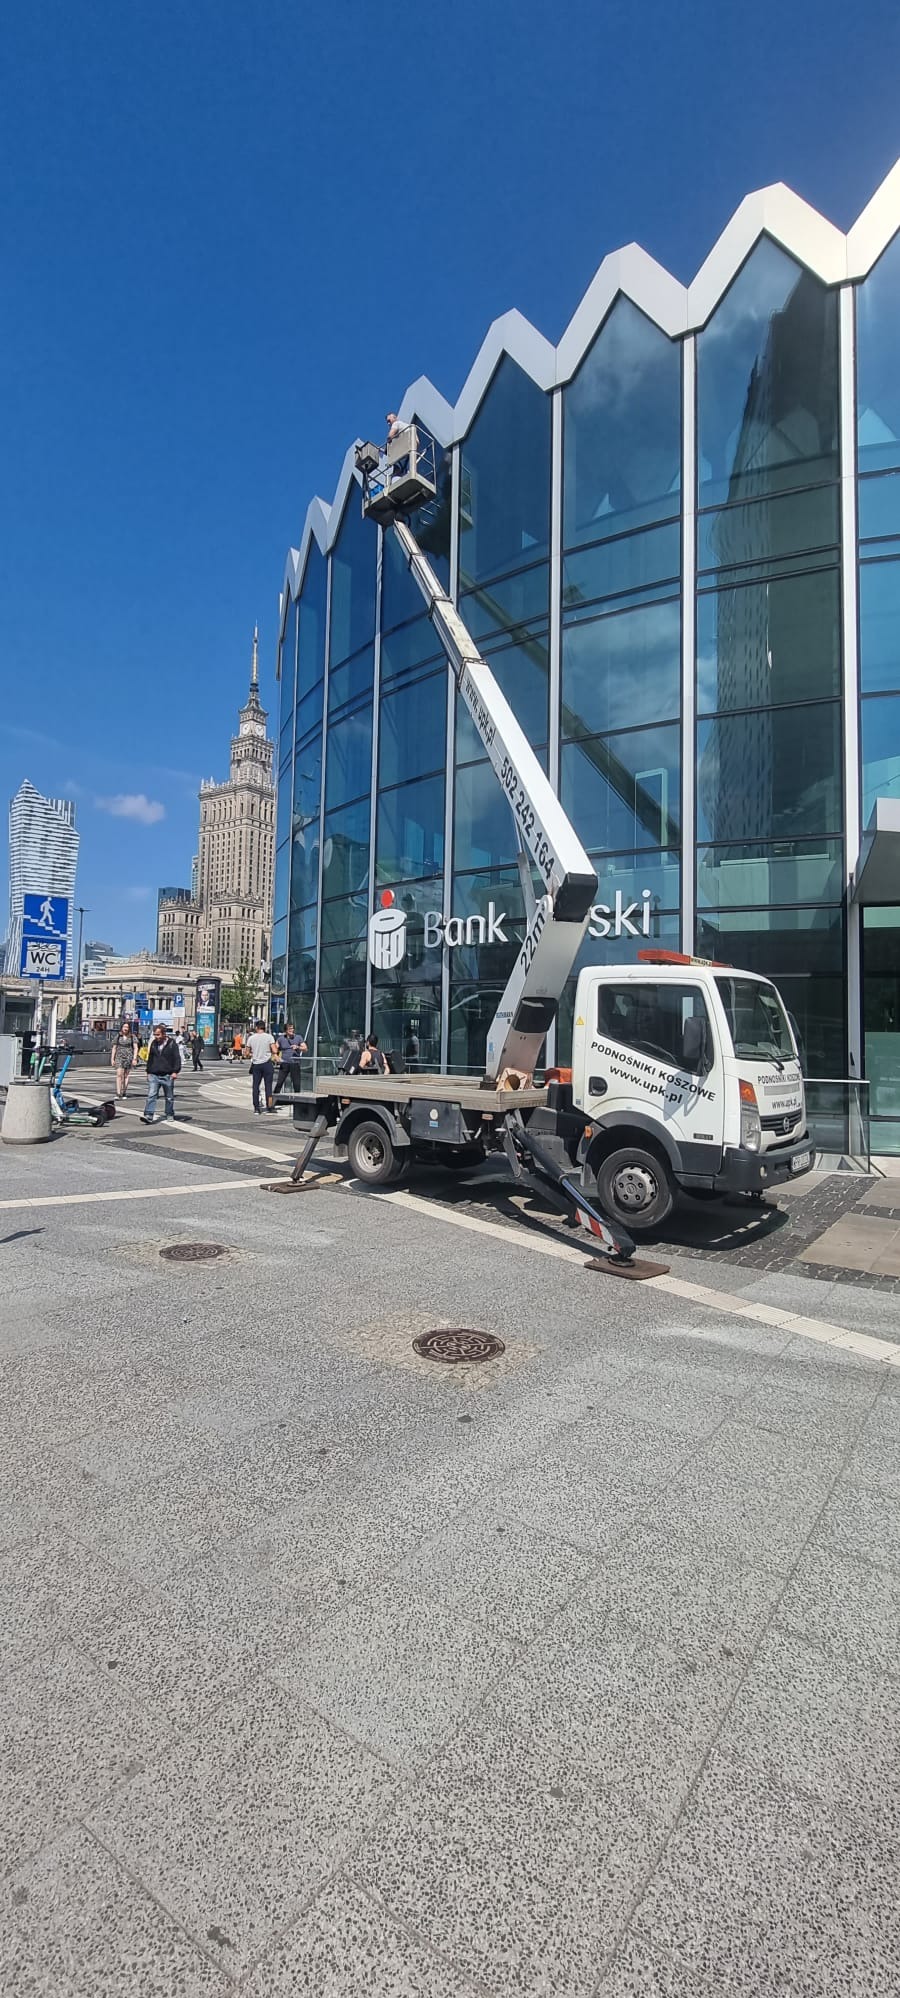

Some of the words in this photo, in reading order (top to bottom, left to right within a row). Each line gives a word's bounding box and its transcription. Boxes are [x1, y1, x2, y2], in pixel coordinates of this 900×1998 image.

[465, 679, 496, 747] www.upk.pl
[501, 756, 518, 801] 502
[515, 790, 535, 838] 242
[533, 831, 555, 881] 164
[423, 901, 509, 949] Bank
[30, 951, 57, 966] WC
[590, 1041, 657, 1076] PODNOŚNIKI
[658, 1070, 717, 1102] KOSZOWE
[609, 1064, 683, 1104] www.upk.pl
